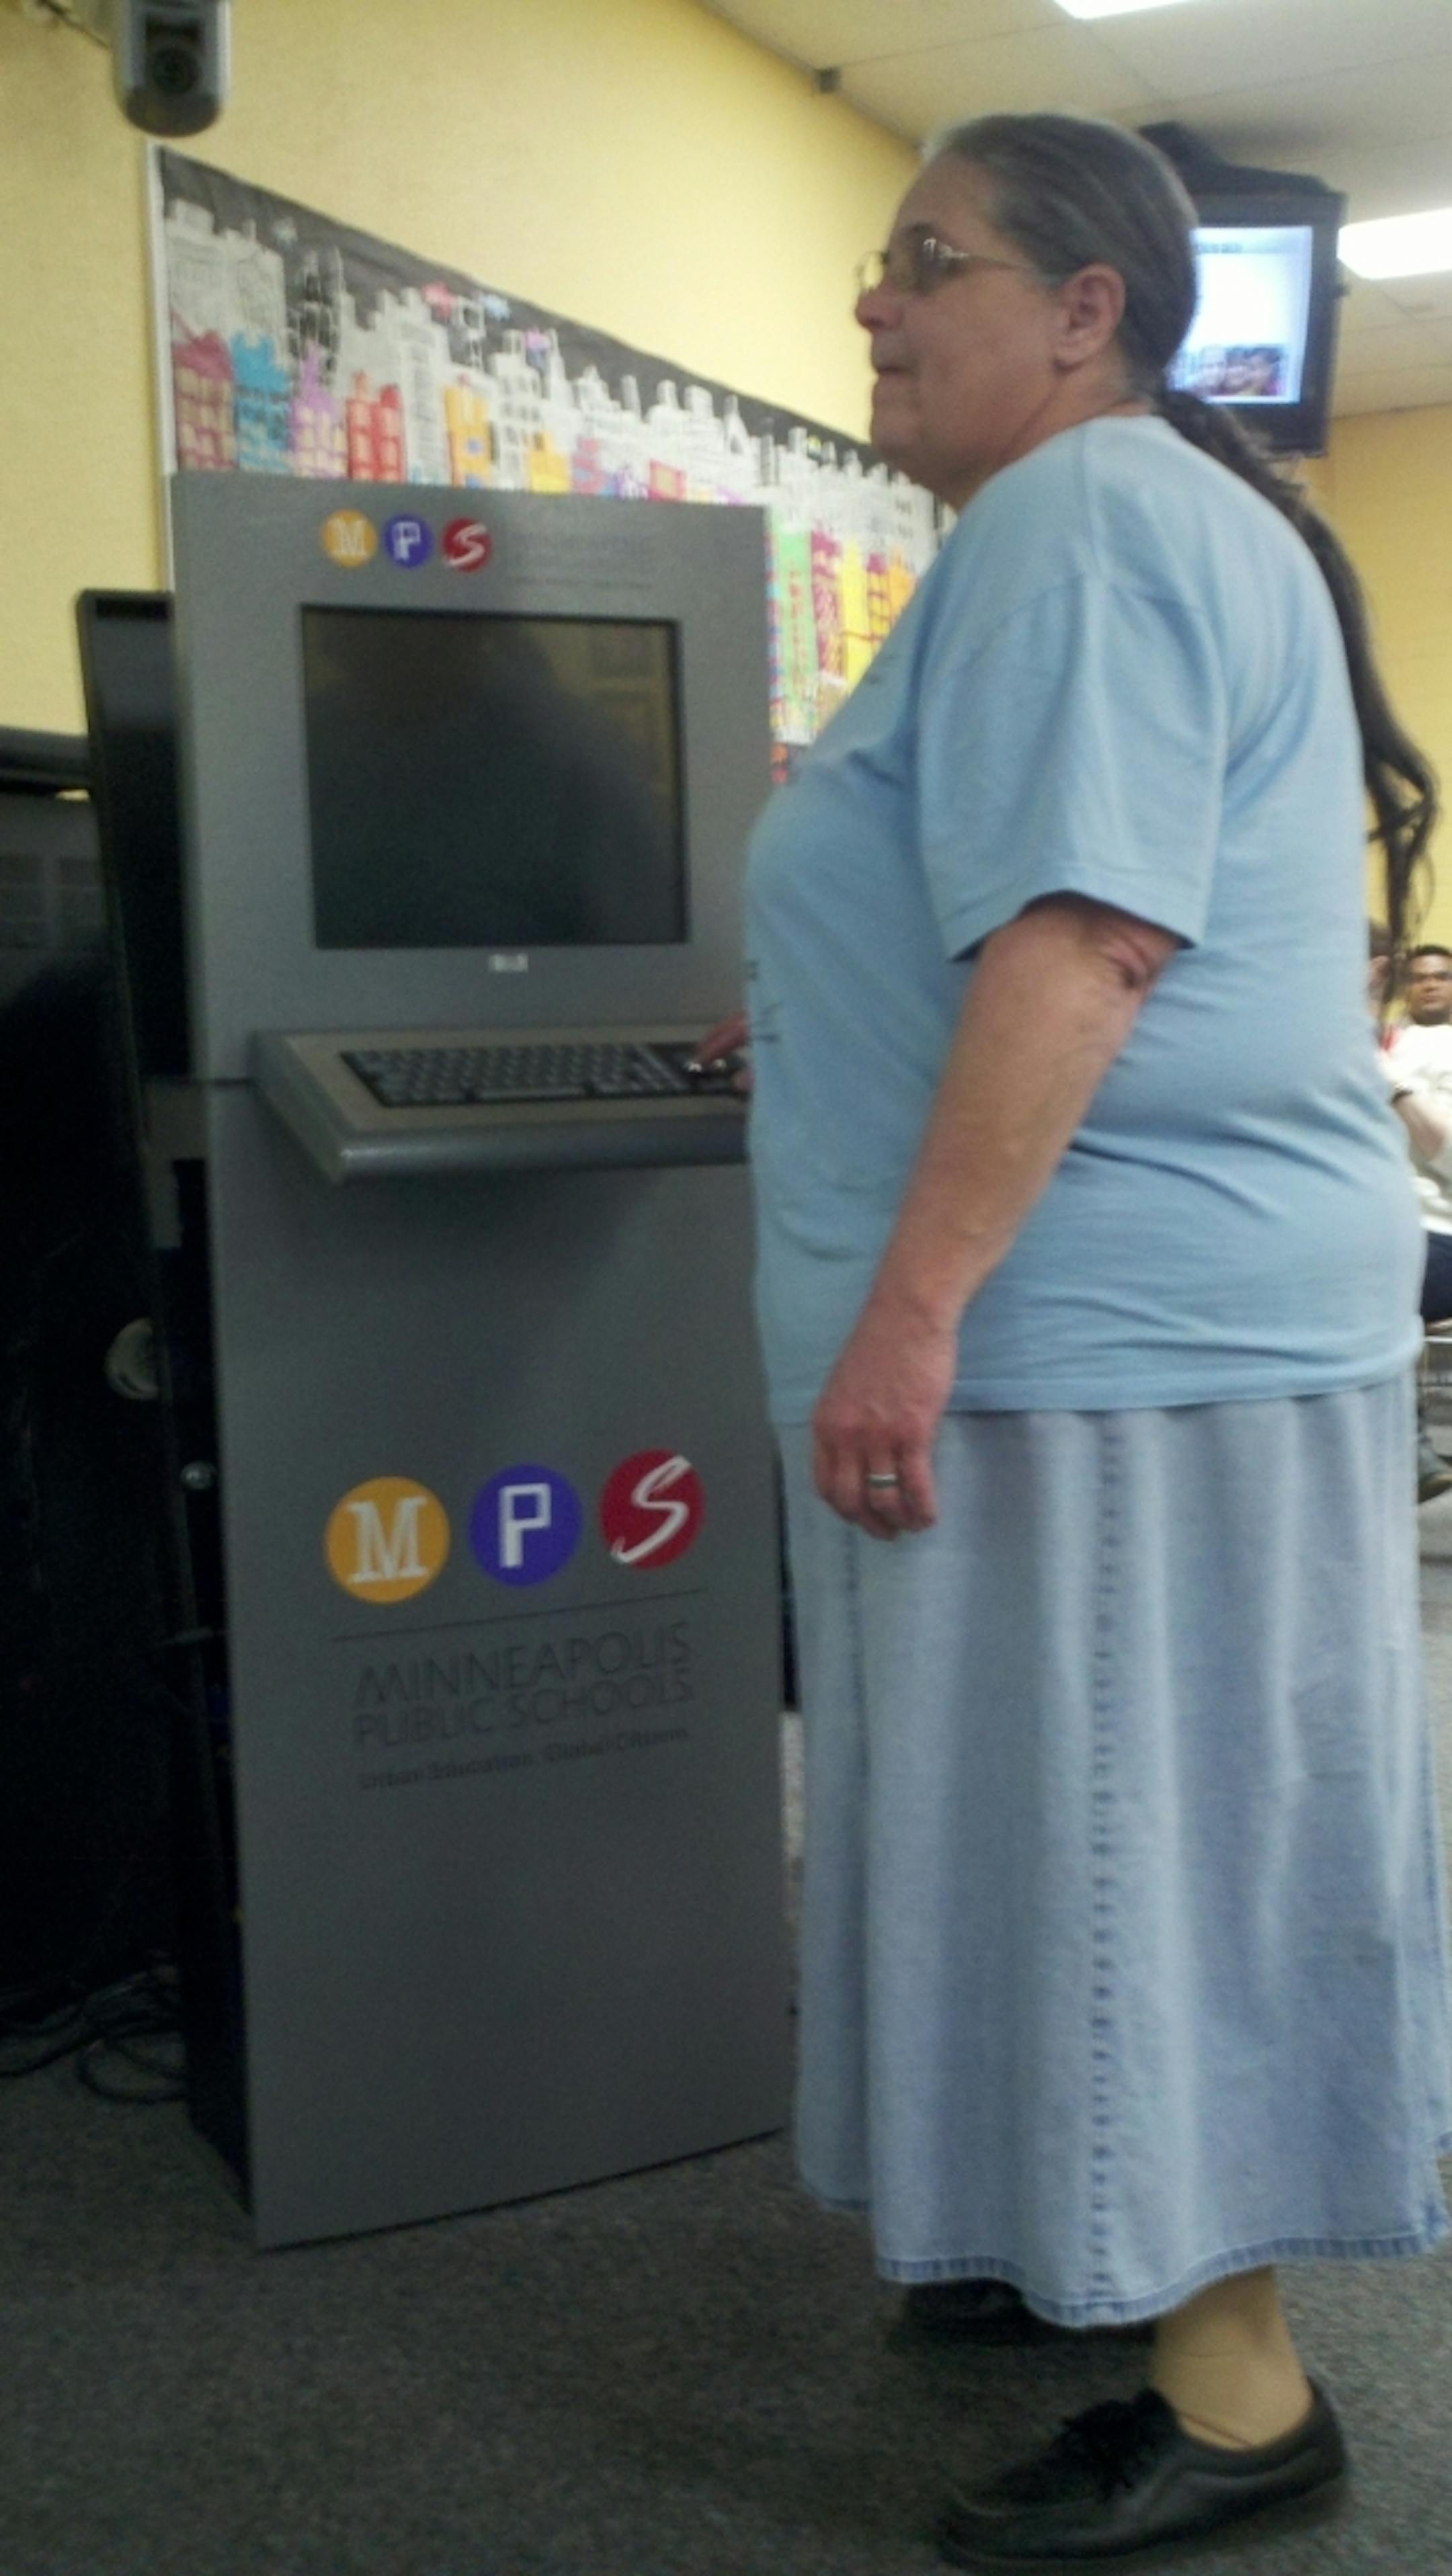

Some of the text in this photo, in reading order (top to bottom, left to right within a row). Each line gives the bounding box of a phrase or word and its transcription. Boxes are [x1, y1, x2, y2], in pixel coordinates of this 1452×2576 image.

[327, 519, 368, 559] M
[391, 521, 421, 560] P
[446, 522, 487, 567] S
[348, 1454, 692, 1583] M P S
[354, 1621, 690, 1707] MINNEAPOLIS
[354, 1667, 694, 1749] PUBLIC SCHOOLS
